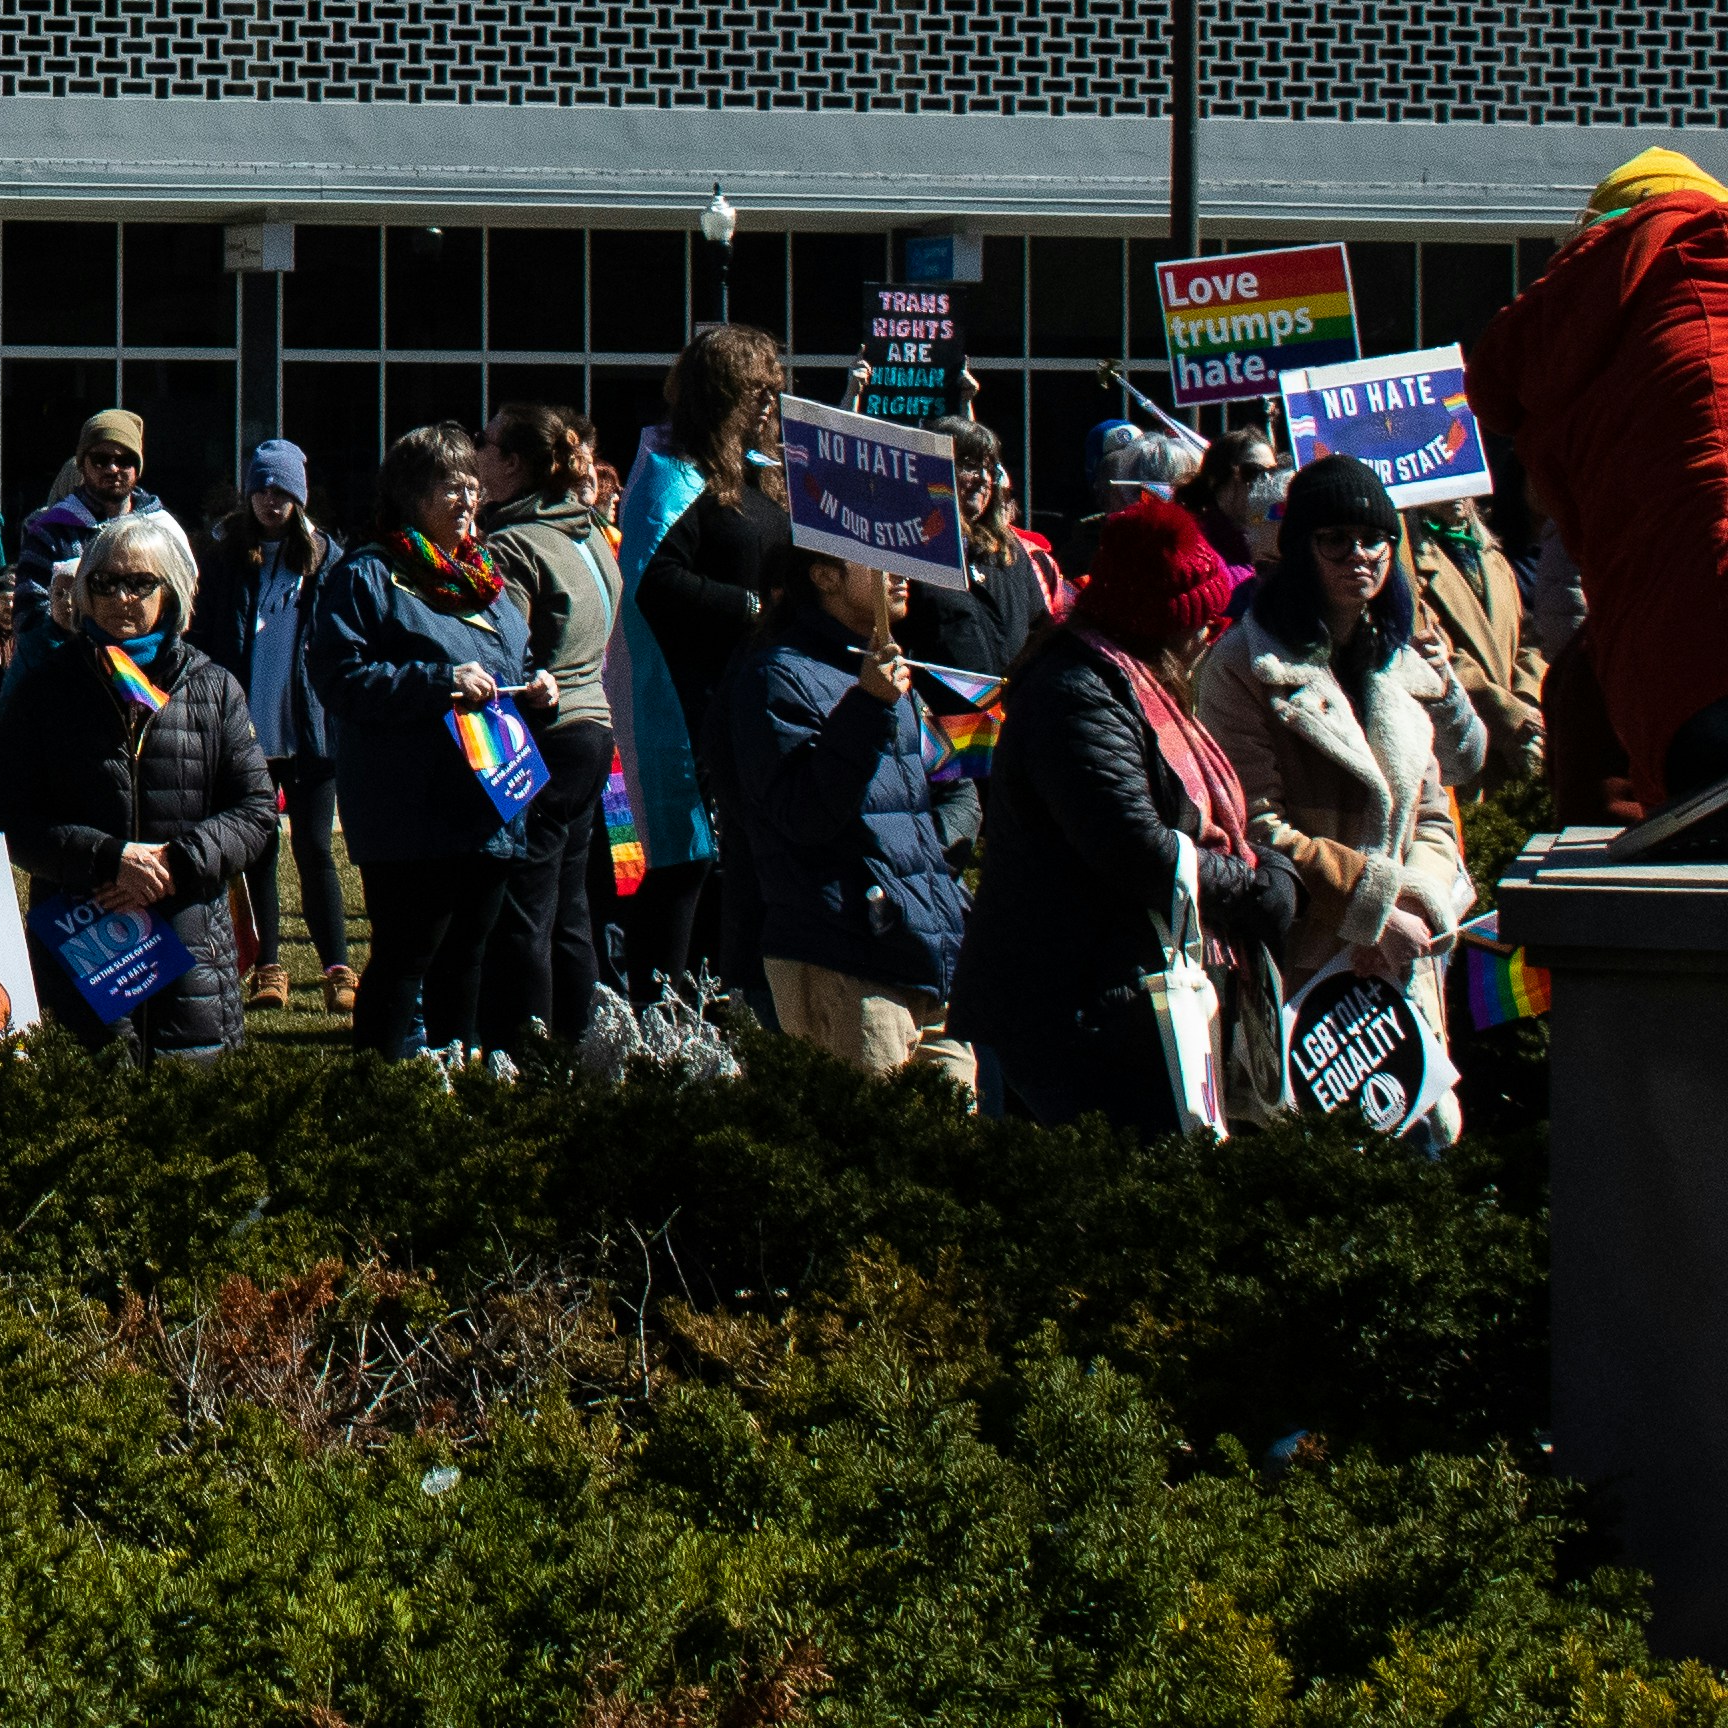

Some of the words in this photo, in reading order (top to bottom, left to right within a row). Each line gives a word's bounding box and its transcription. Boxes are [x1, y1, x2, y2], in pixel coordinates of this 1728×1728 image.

[878, 291, 951, 314] TRANS
[1164, 271, 1259, 308] Love
[872, 317, 954, 340] RIGHTS
[1171, 305, 1314, 348] trumps
[887, 342, 933, 363] ARE
[1176, 351, 1277, 390] hate.
[870, 367, 945, 387] HUMAN
[1321, 387, 1358, 419] NO
[1365, 375, 1436, 414] HATE
[866, 394, 946, 416] RIGHTS
[817, 428, 845, 465] NO
[856, 439, 920, 485] HATE
[1364, 456, 1395, 485] UR
[1398, 434, 1456, 482] STATE
[819, 489, 839, 520] IN
[841, 505, 870, 543] OUR
[873, 516, 930, 547] STATE
[54, 897, 106, 935] VOT
[58, 908, 153, 979] NO
[1290, 980, 1383, 1082] LGBTQIA+
[1310, 1005, 1407, 1113] EQUALITY
